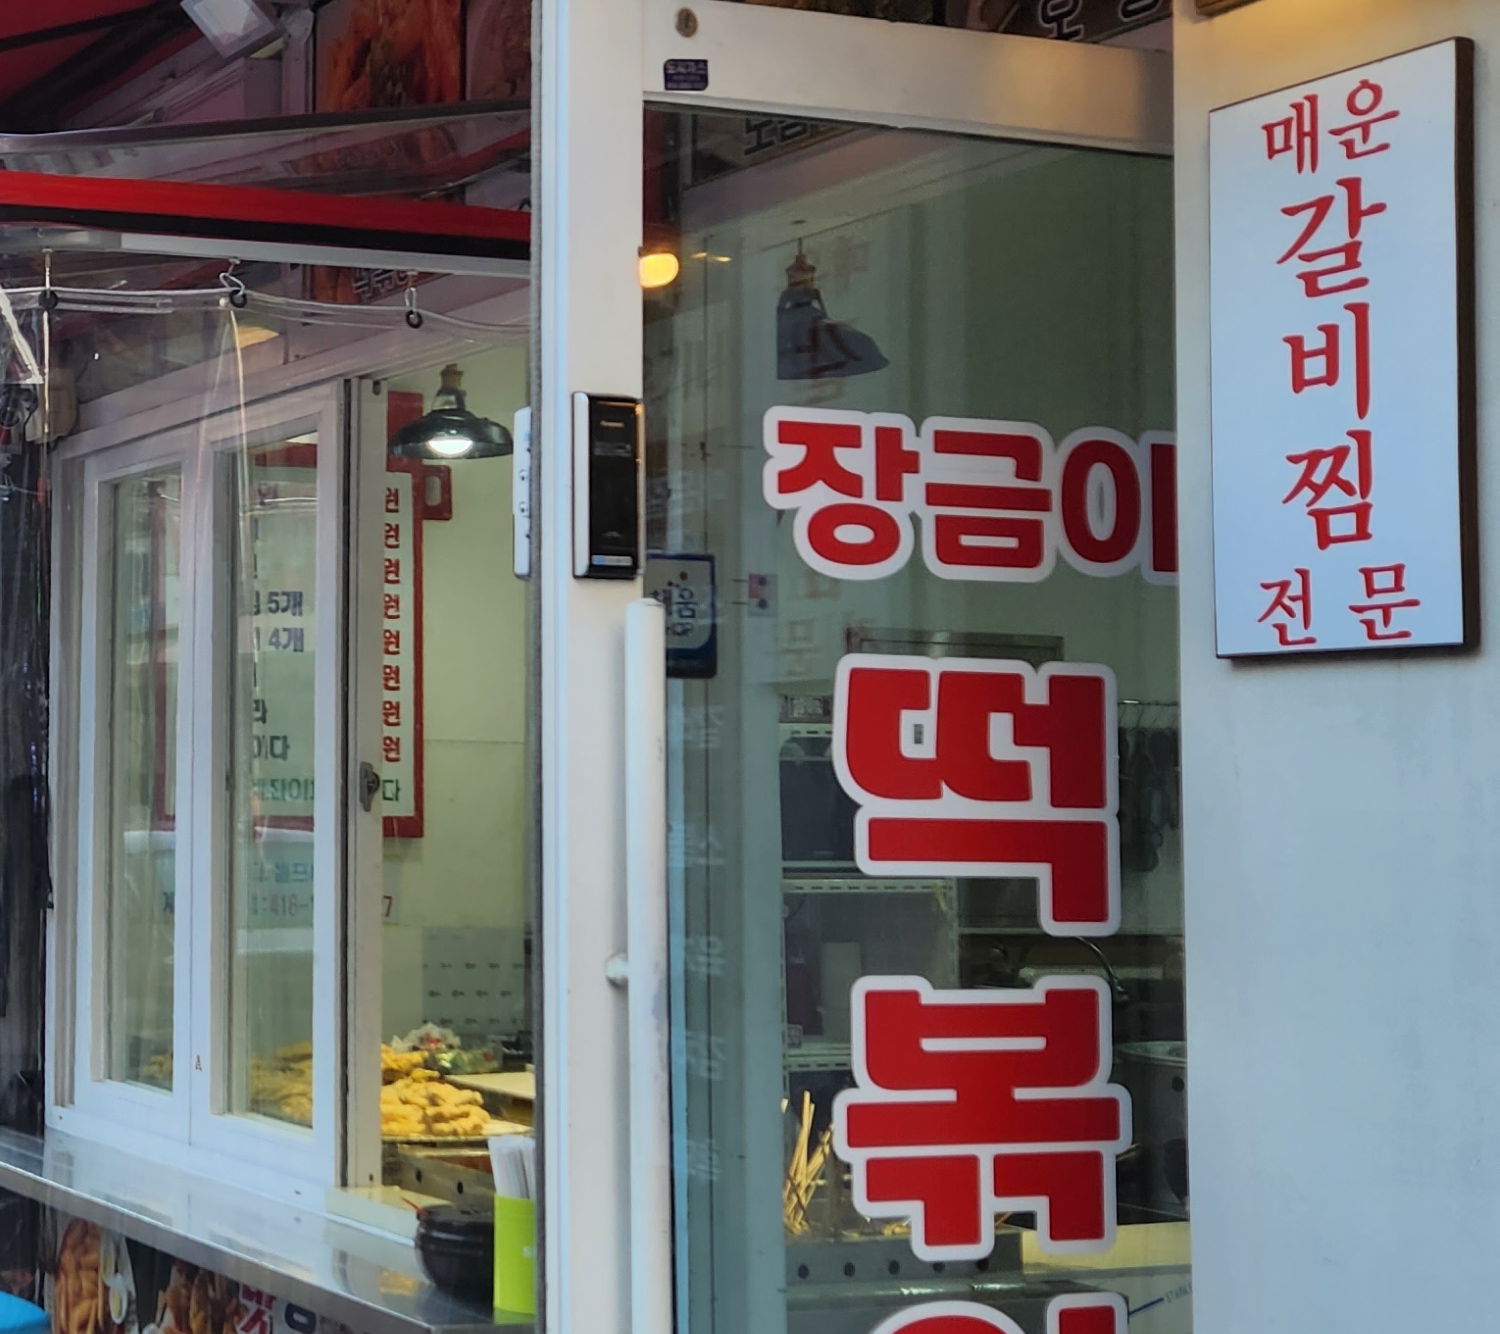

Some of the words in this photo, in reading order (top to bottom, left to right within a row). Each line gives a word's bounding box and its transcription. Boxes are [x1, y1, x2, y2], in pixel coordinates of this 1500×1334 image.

[1260, 78, 1401, 175] 매운
[1275, 176, 1388, 551] 갈비찜
[768, 411, 1179, 580] 장금이
[1257, 561, 1421, 648] 전문
